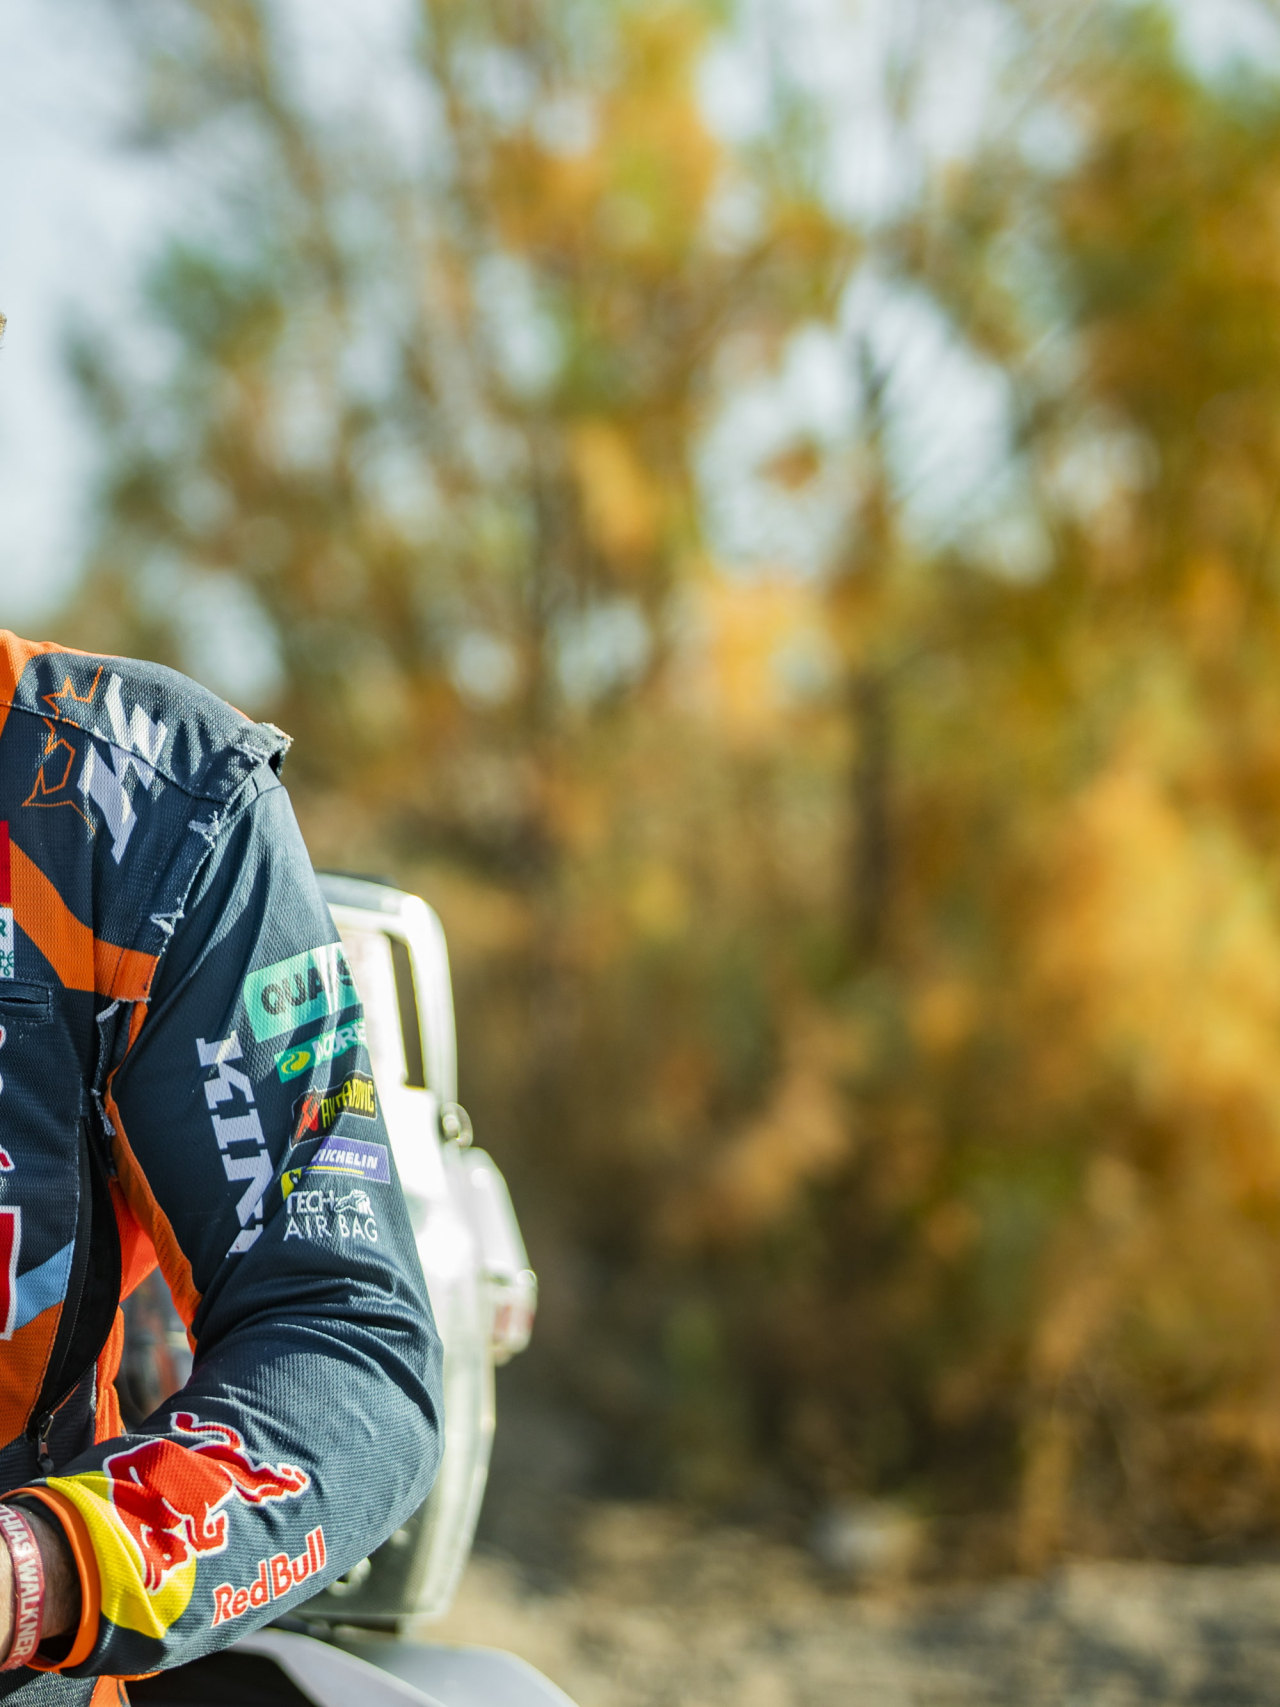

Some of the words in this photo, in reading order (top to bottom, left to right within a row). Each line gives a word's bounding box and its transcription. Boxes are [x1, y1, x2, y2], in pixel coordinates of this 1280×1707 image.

[13, 1558, 40, 1658] WALKNER
[211, 1558, 271, 1628] Red
[269, 1525, 327, 1600] Bull
